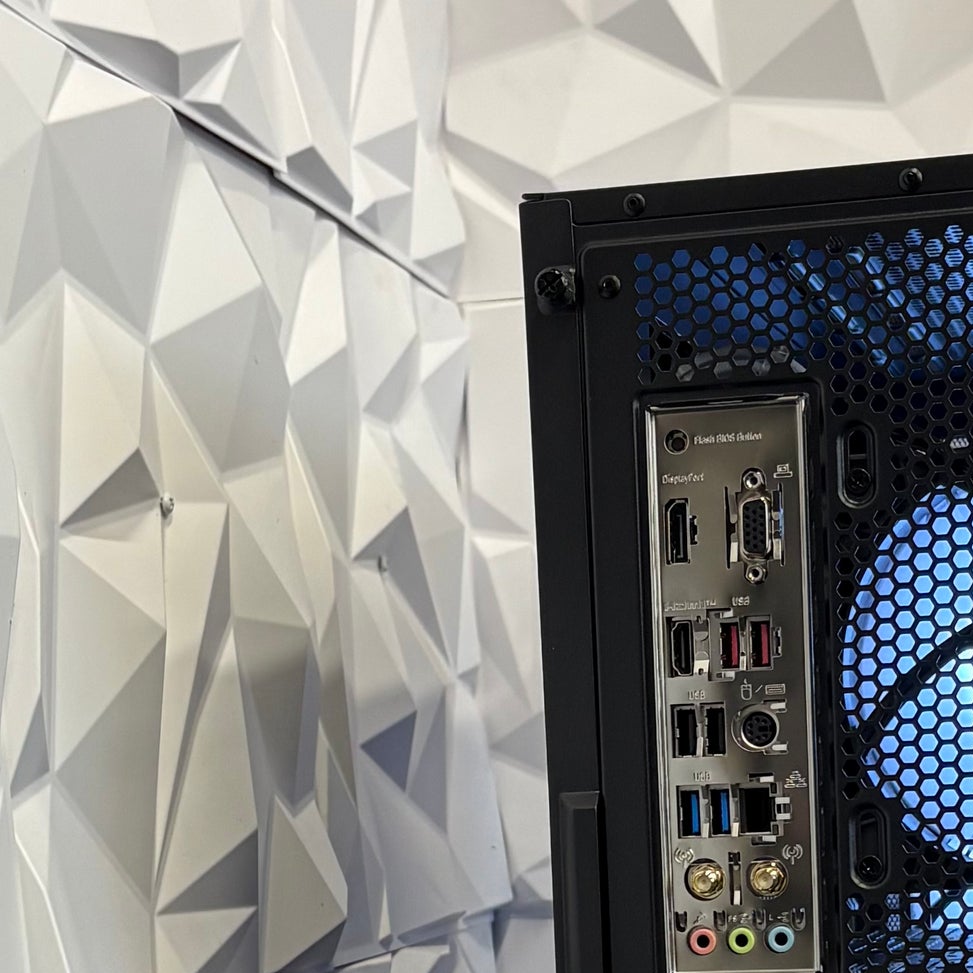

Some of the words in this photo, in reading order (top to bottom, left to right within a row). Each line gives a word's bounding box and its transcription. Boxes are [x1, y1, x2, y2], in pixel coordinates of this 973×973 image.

[694, 435, 715, 445] Flash
[716, 433, 736, 443] BIOS
[737, 431, 762, 442] Button
[662, 472, 705, 485] DisplayPort
[731, 596, 750, 606] USB
